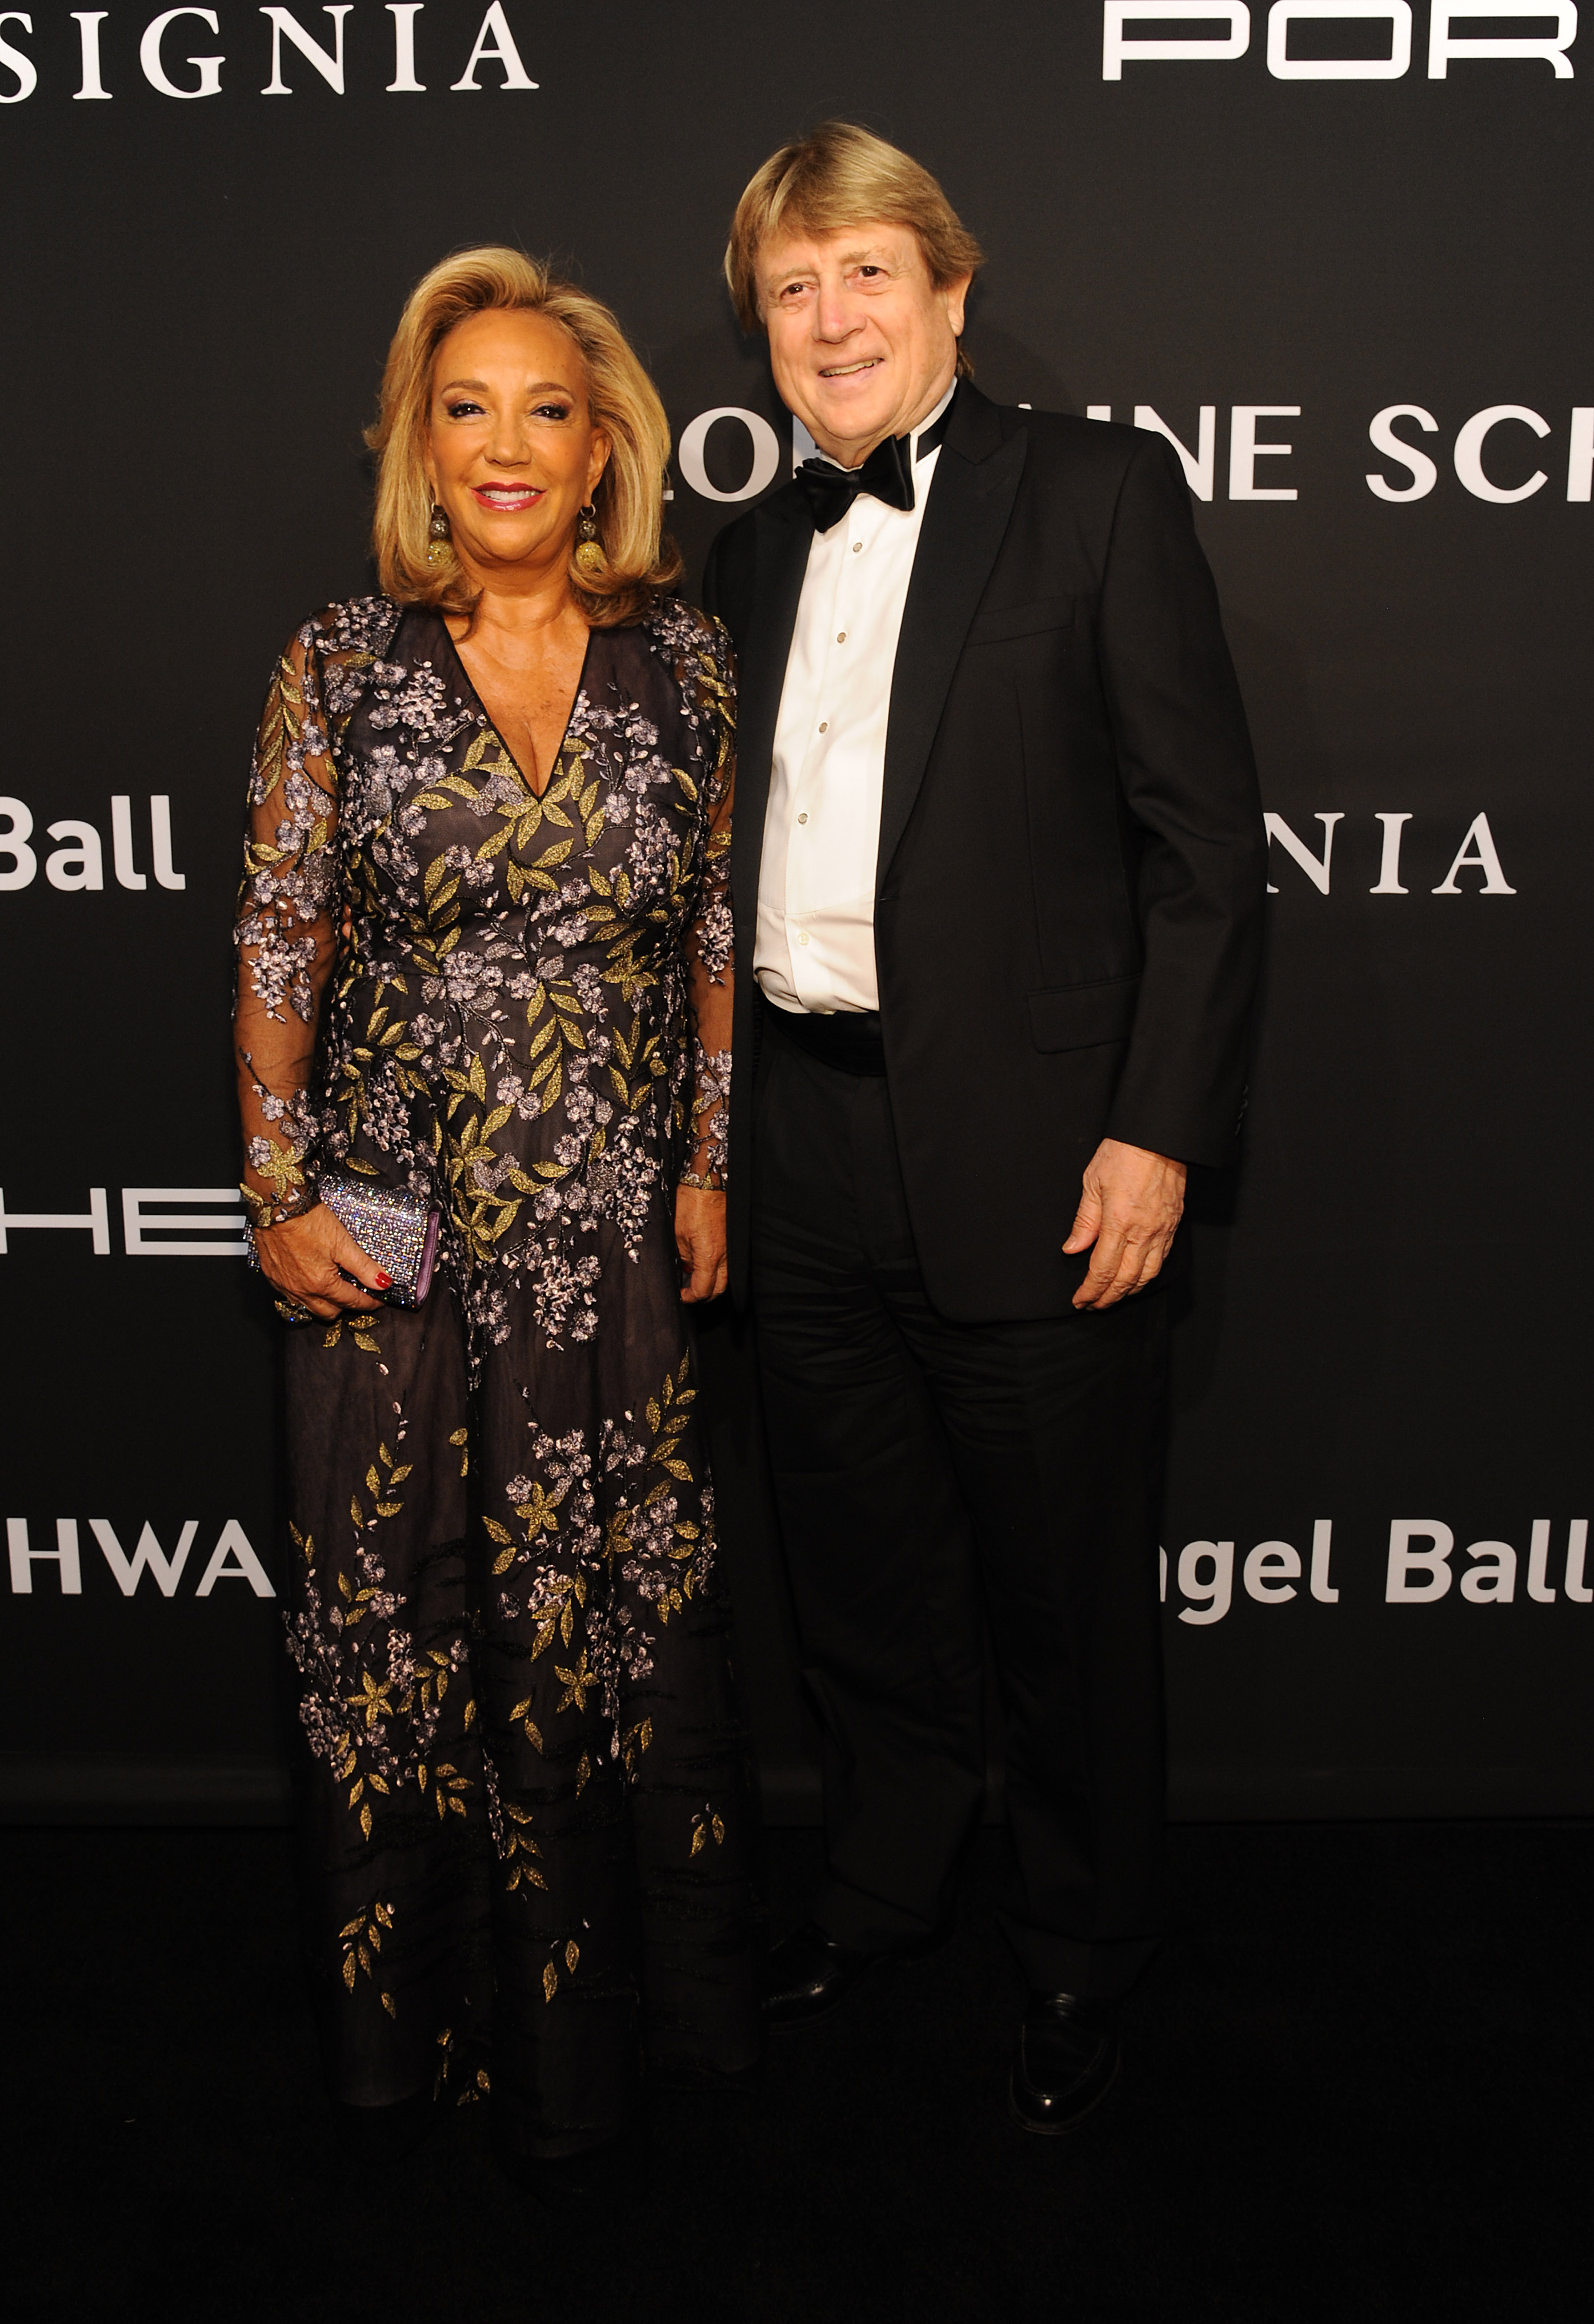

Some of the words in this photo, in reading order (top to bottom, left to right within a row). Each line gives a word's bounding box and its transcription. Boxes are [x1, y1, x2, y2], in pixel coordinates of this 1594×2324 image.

[1103, 0, 1577, 81] POR
[6, 1518, 277, 1597] HWA
[1160, 1519, 1339, 1625] gel
[1385, 1519, 1593, 1603] Ball
